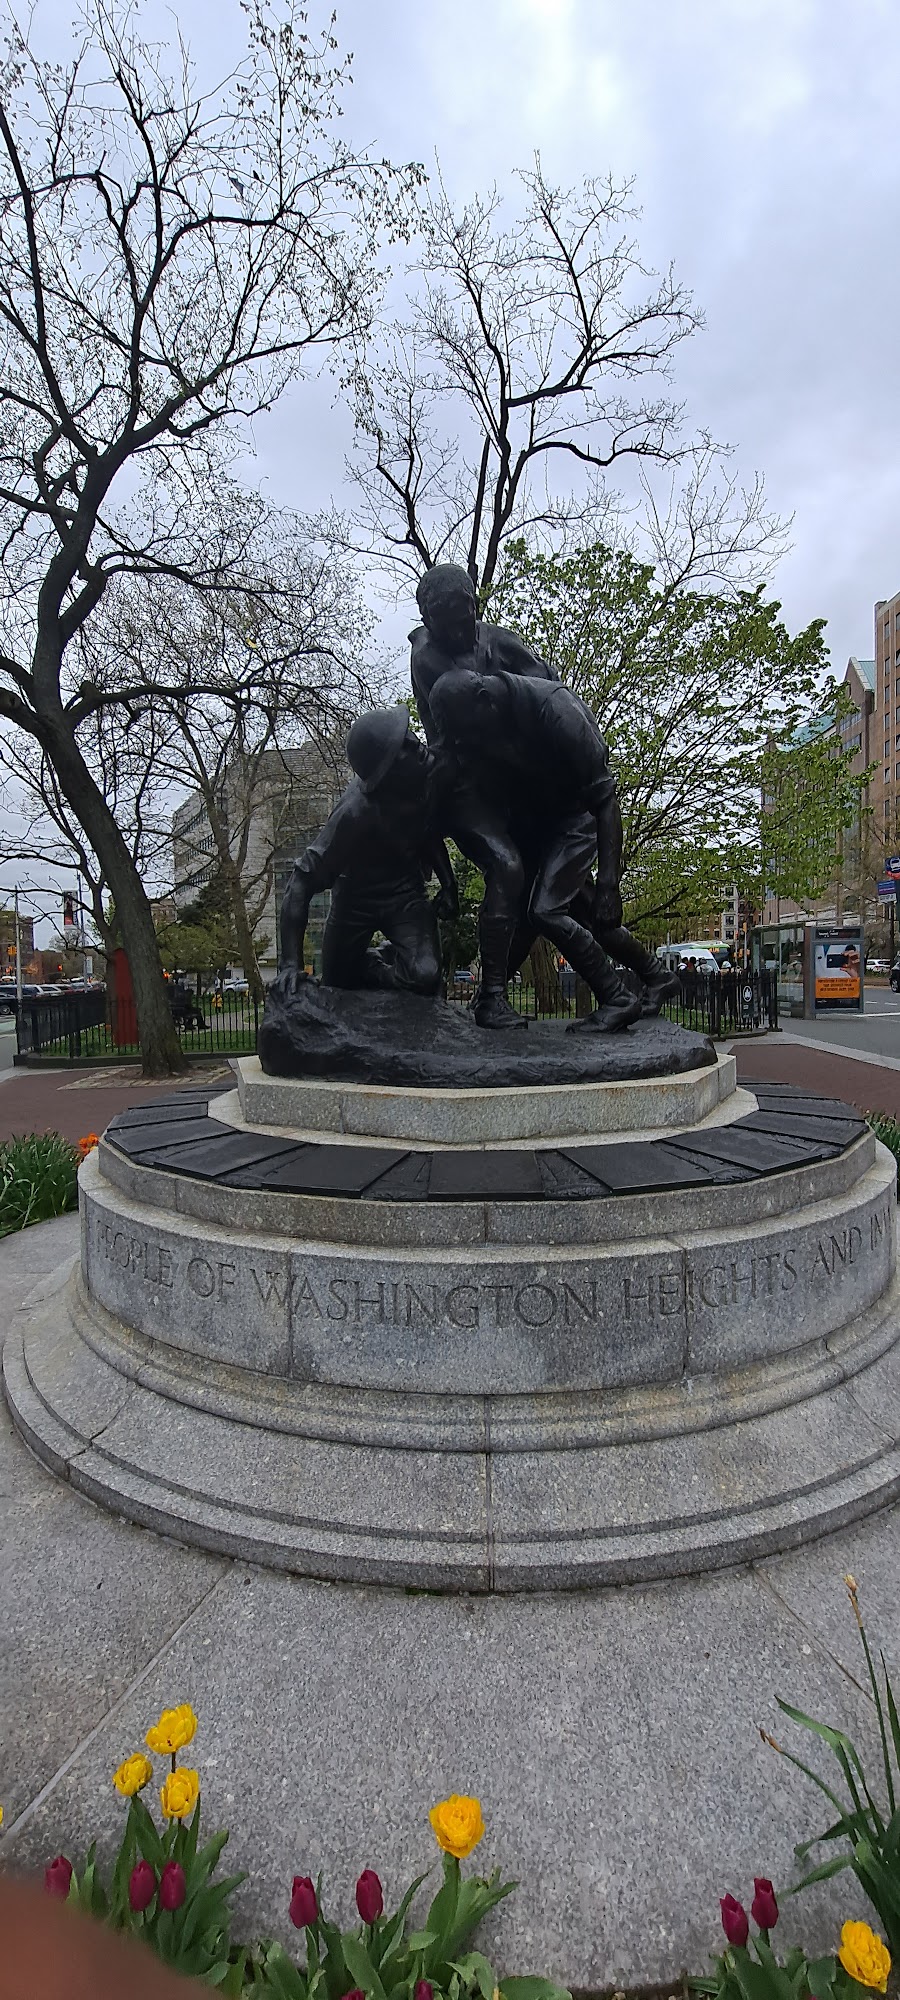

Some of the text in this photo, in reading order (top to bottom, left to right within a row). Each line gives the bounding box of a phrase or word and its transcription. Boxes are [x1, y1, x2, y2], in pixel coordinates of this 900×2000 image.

[187, 1257, 236, 1303] OF
[249, 1267, 599, 1329] WASHINGTON
[622, 1249, 797, 1320] HEIGHTS
[806, 1226, 862, 1283] AND
